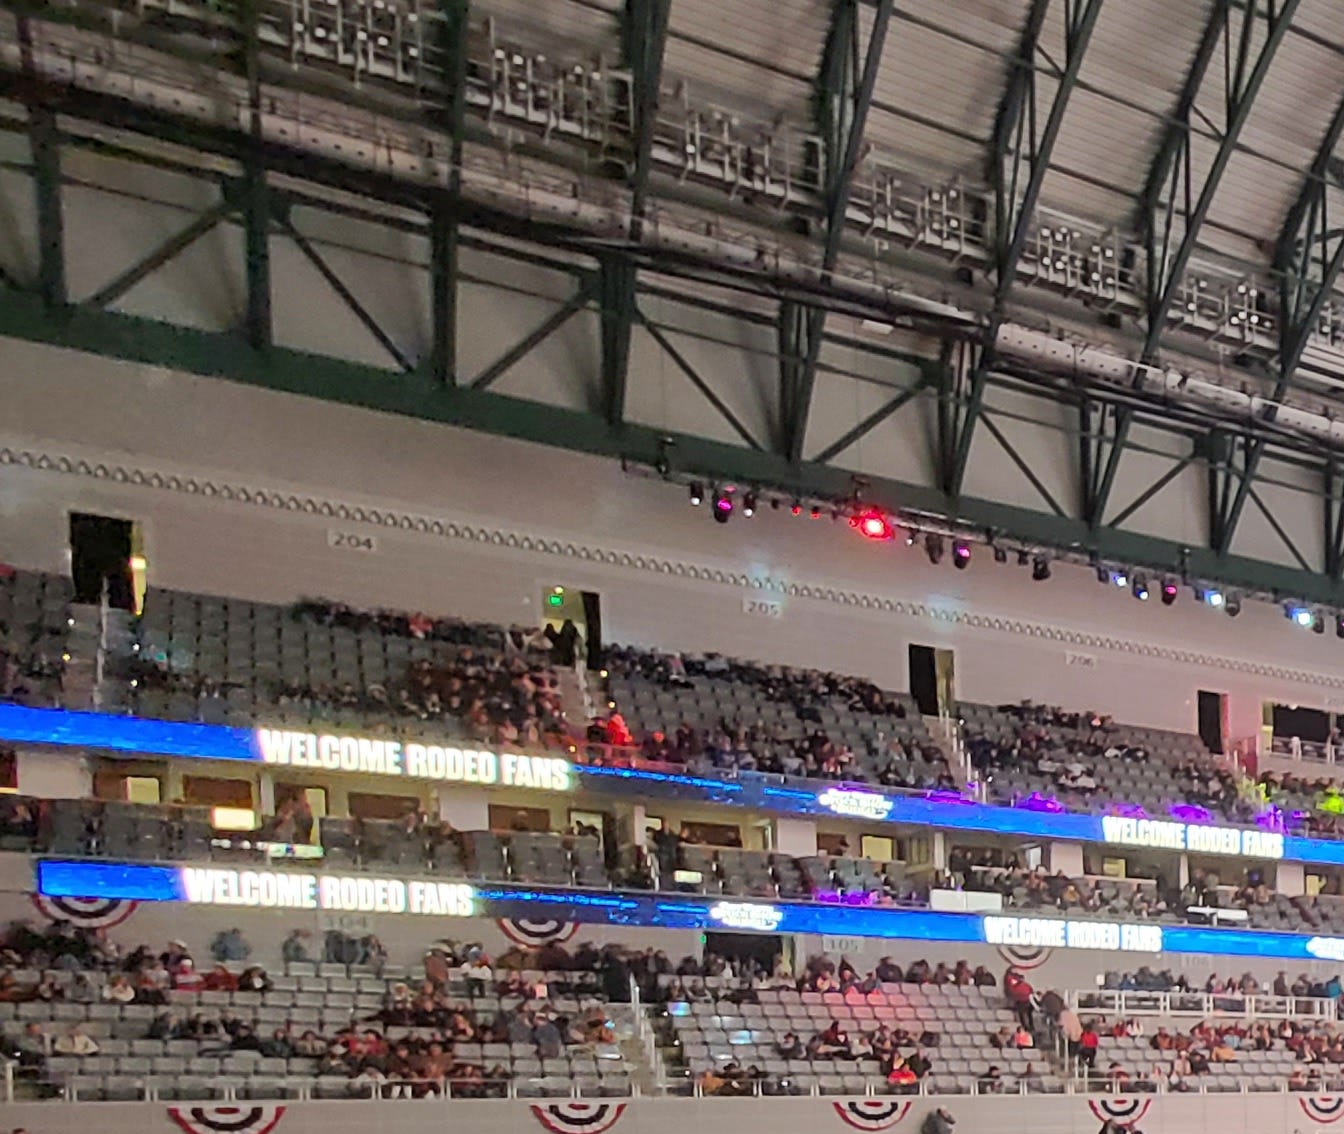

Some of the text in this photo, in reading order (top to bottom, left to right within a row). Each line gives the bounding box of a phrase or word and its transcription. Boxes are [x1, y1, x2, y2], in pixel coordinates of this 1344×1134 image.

[334, 533, 373, 549] 204
[748, 601, 779, 616] 205
[259, 728, 571, 790] WELCOME RODEO FANS
[1102, 816, 1285, 858] WELCOME RODEO FANS
[184, 867, 475, 917] WELCOME RODEO FANS
[983, 916, 1162, 952] WELCOME RODEO FANS
